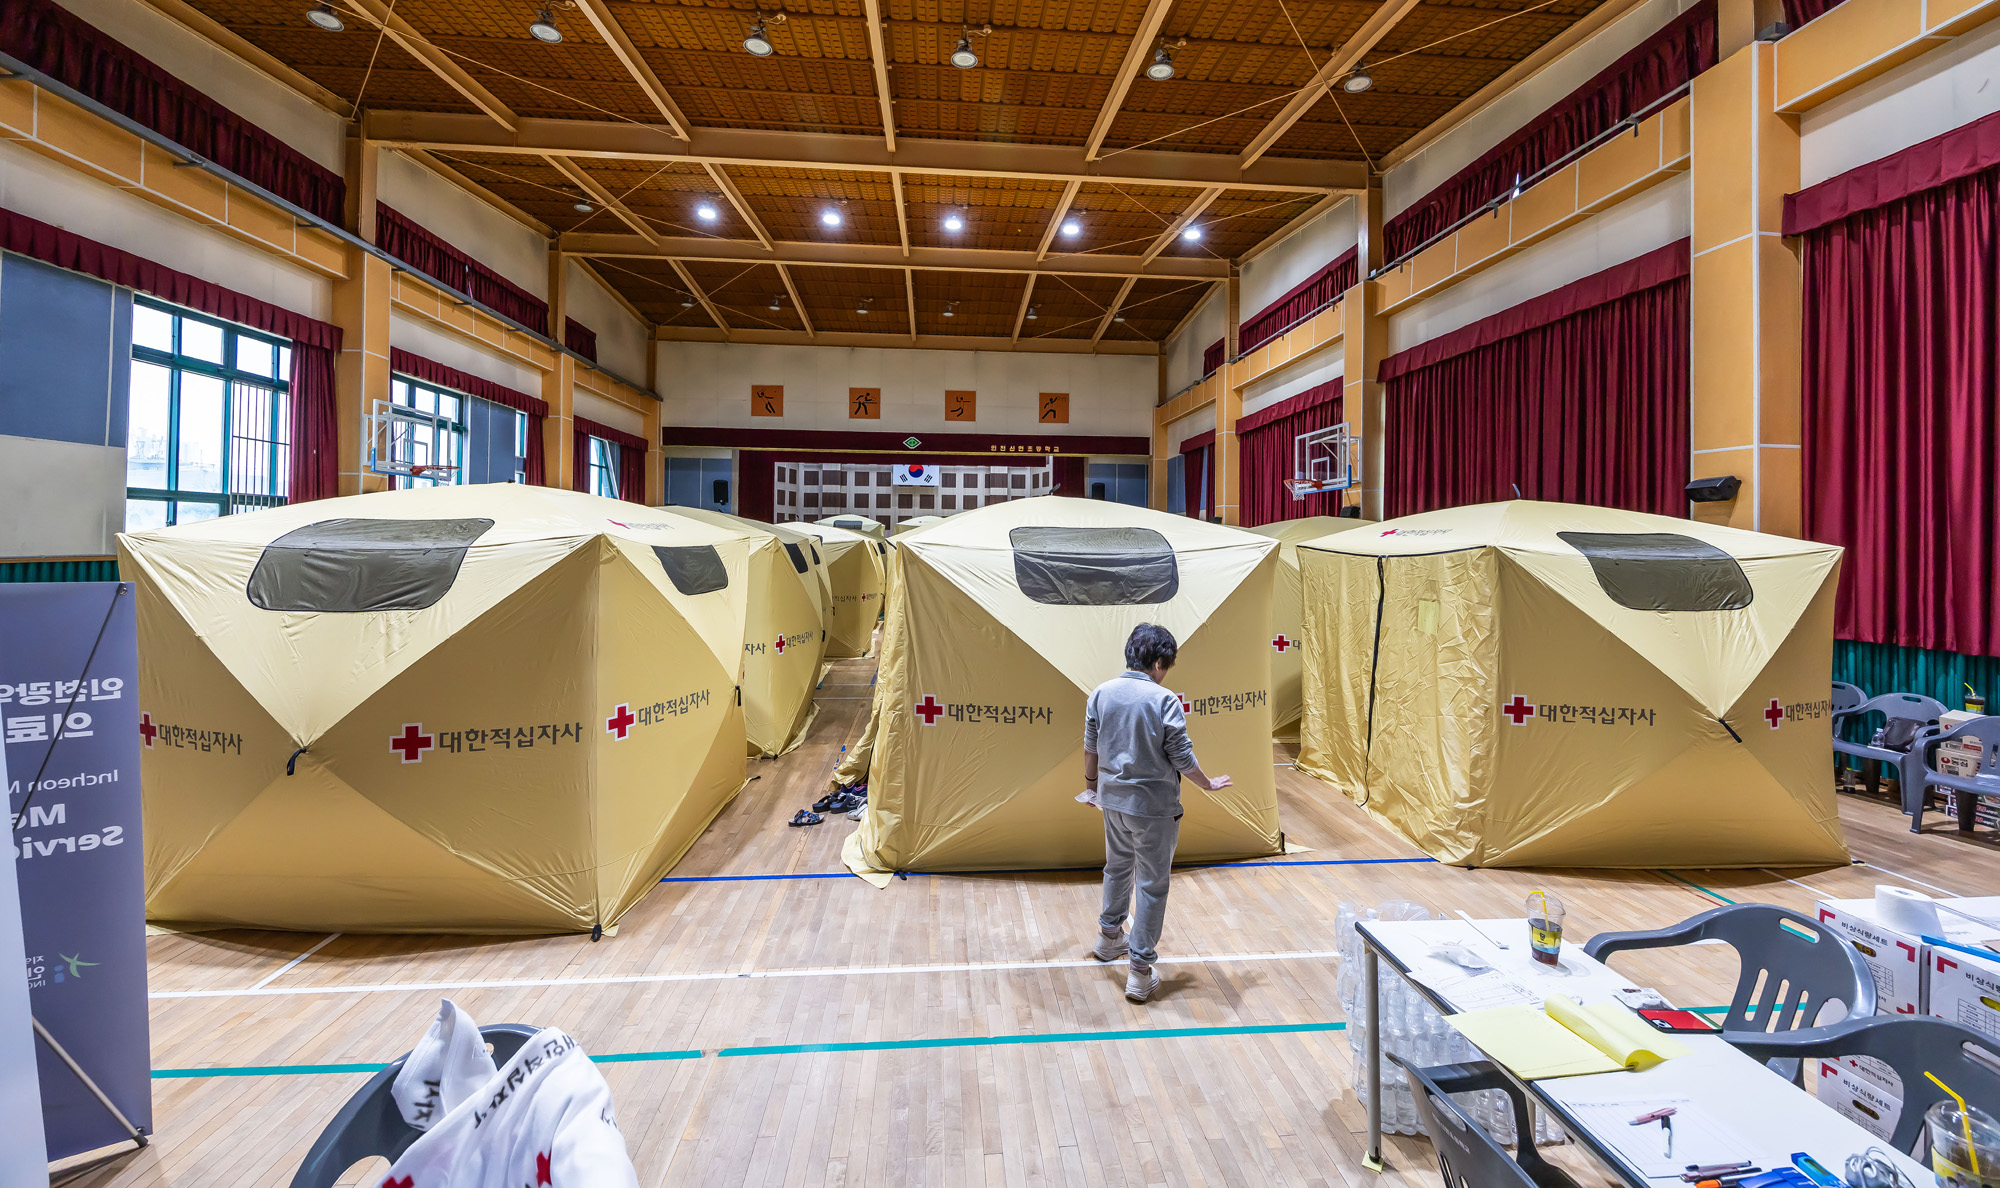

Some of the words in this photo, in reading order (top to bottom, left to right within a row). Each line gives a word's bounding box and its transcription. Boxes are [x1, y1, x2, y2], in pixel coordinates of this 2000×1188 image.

[638, 689, 710, 727] 대한적십자사
[948, 703, 1053, 725] 대한적십자사
[1193, 689, 1267, 716] 대한적십자사
[1539, 703, 1656, 727] 대한적십자사
[159, 724, 243, 755] 대한적십자사
[438, 722, 583, 753] 대한적십자사
